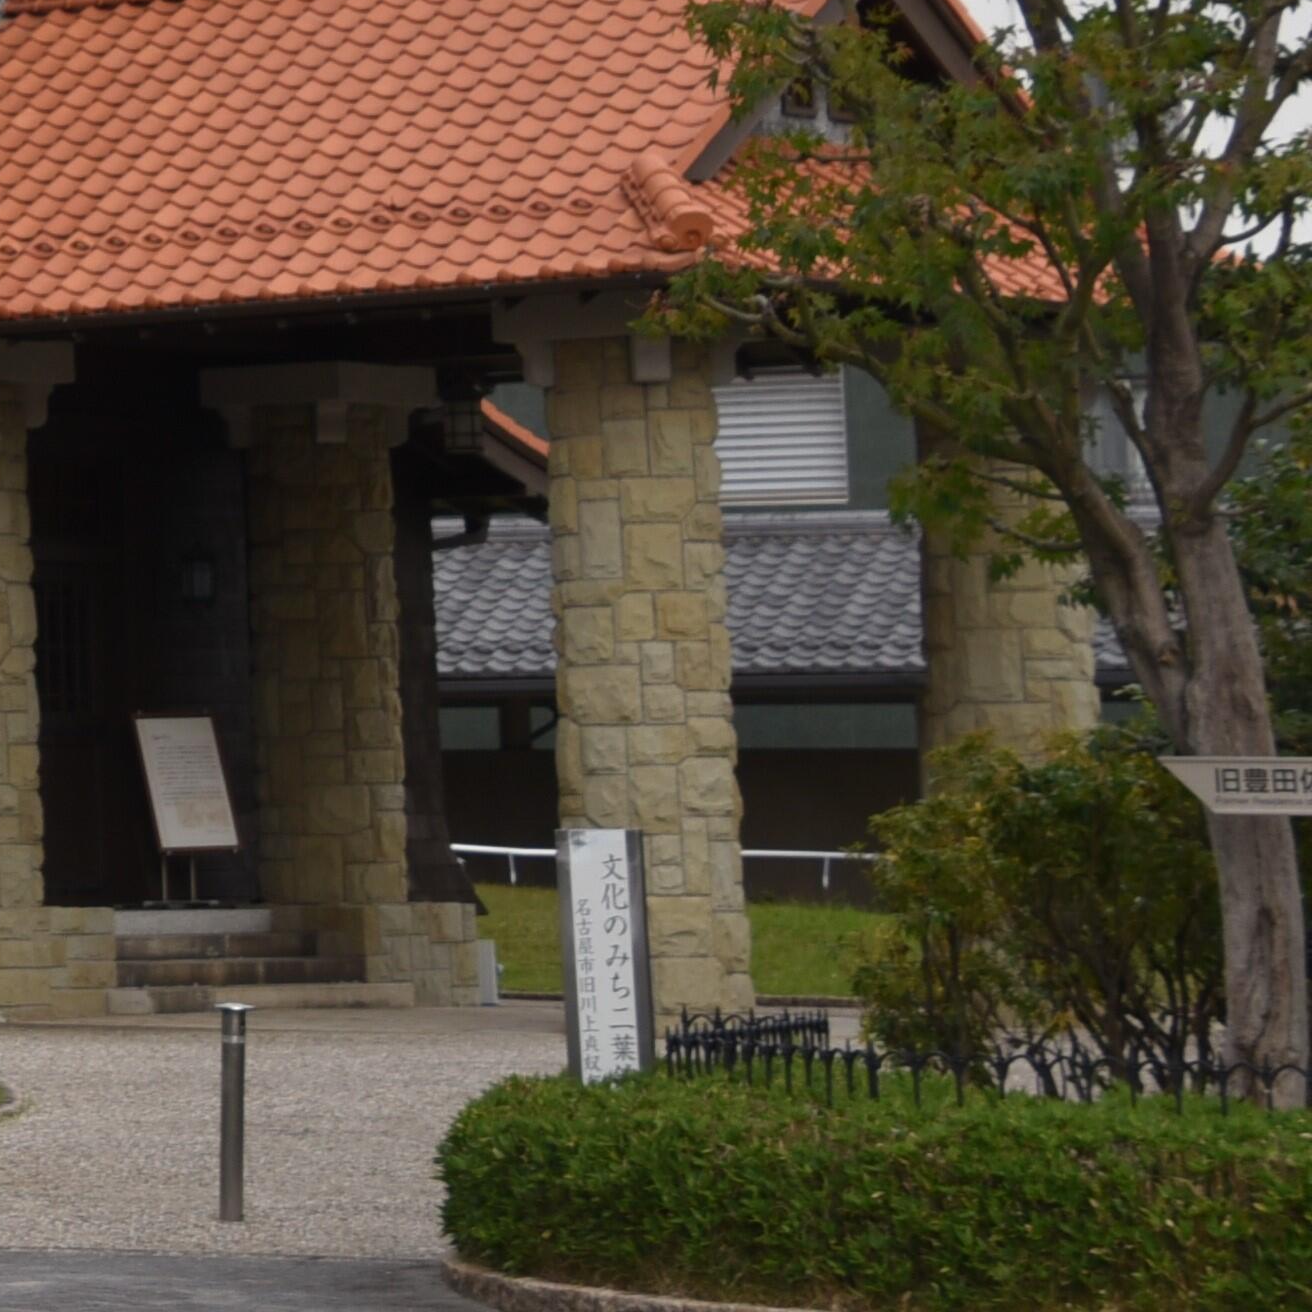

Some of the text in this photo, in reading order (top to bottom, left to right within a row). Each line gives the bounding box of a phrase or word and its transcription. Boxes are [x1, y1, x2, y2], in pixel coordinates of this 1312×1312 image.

[576, 898, 602, 1082] 名古屋市旧川上貞奴
[601, 854, 636, 1074] 文化のみち二葉
